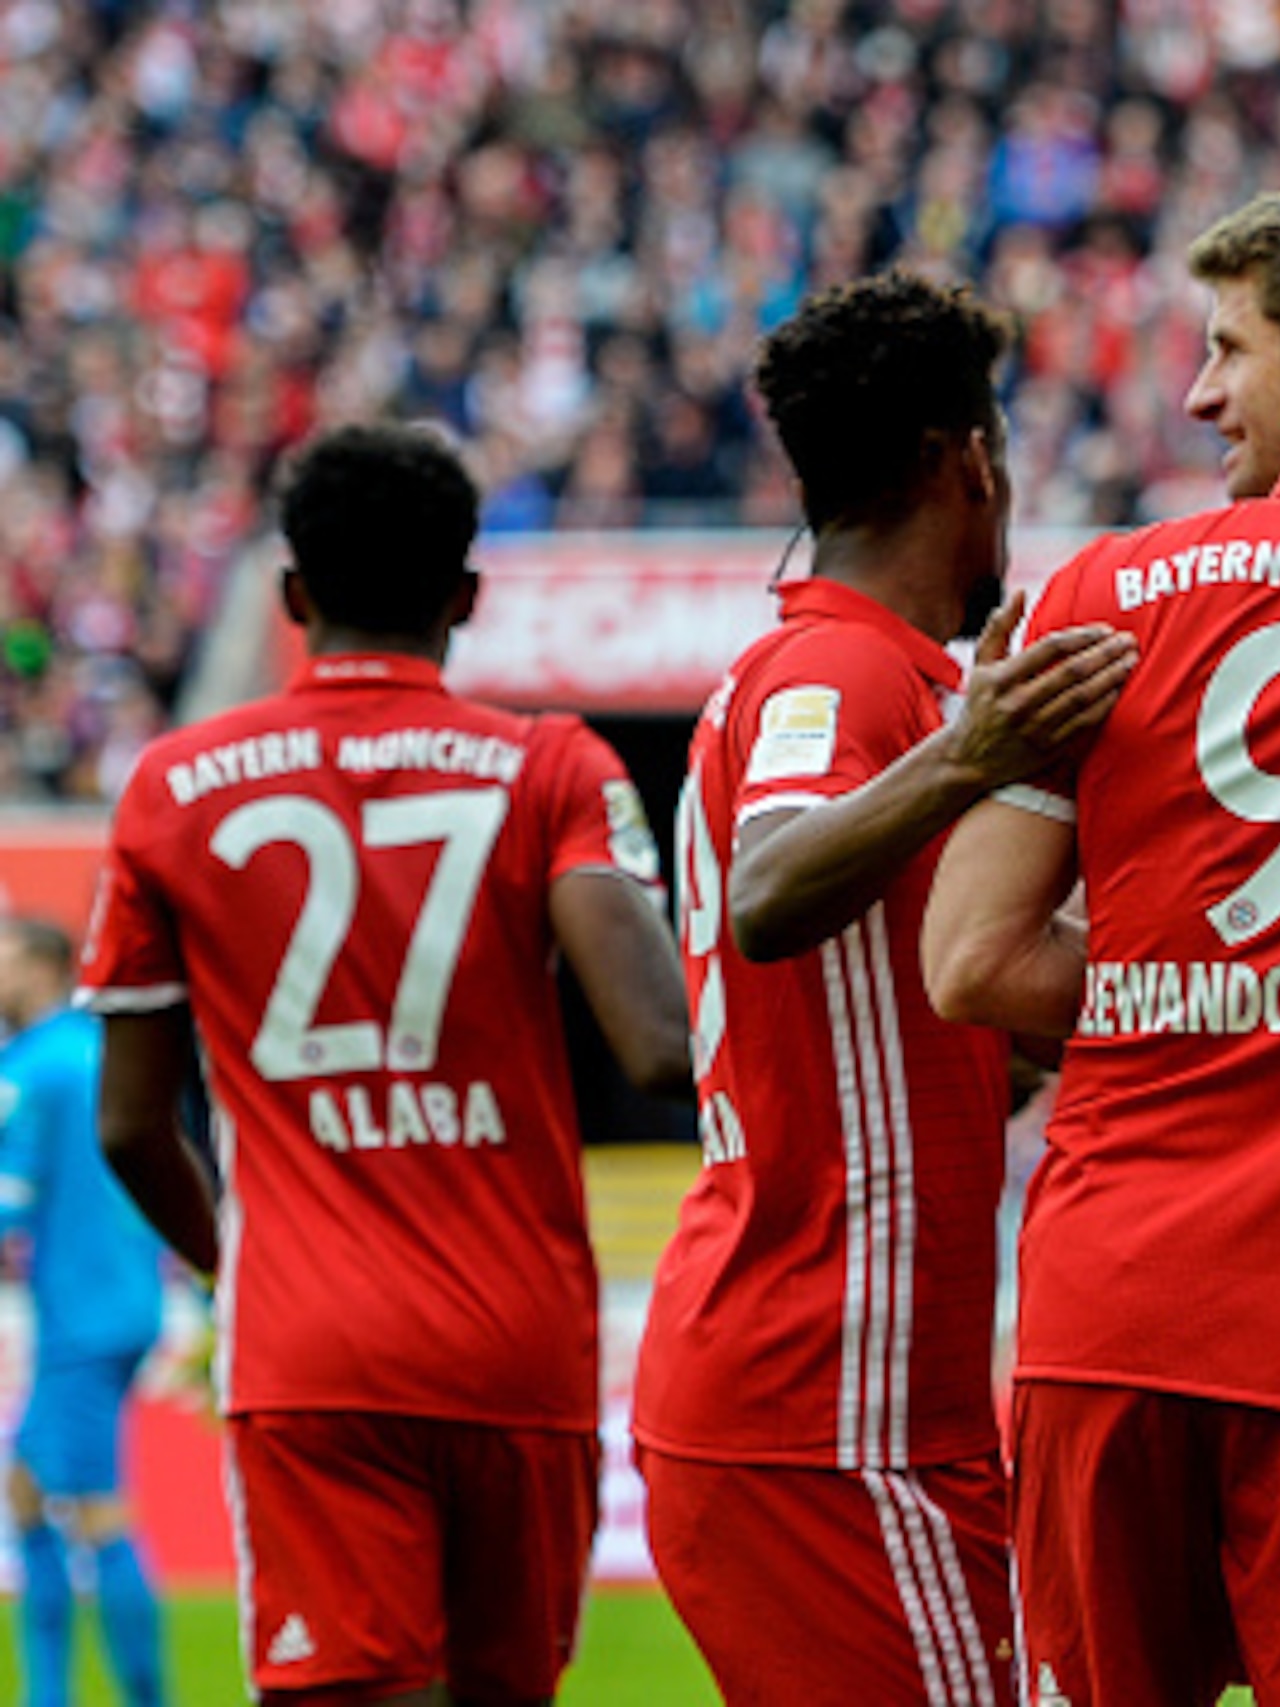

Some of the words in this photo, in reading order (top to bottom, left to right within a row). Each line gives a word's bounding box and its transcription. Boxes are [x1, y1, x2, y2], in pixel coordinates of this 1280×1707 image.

[166, 728, 320, 806] BAYERN
[337, 728, 525, 784] MÜNCHEN
[209, 786, 510, 1081] 27
[308, 1080, 506, 1153] ALABA
